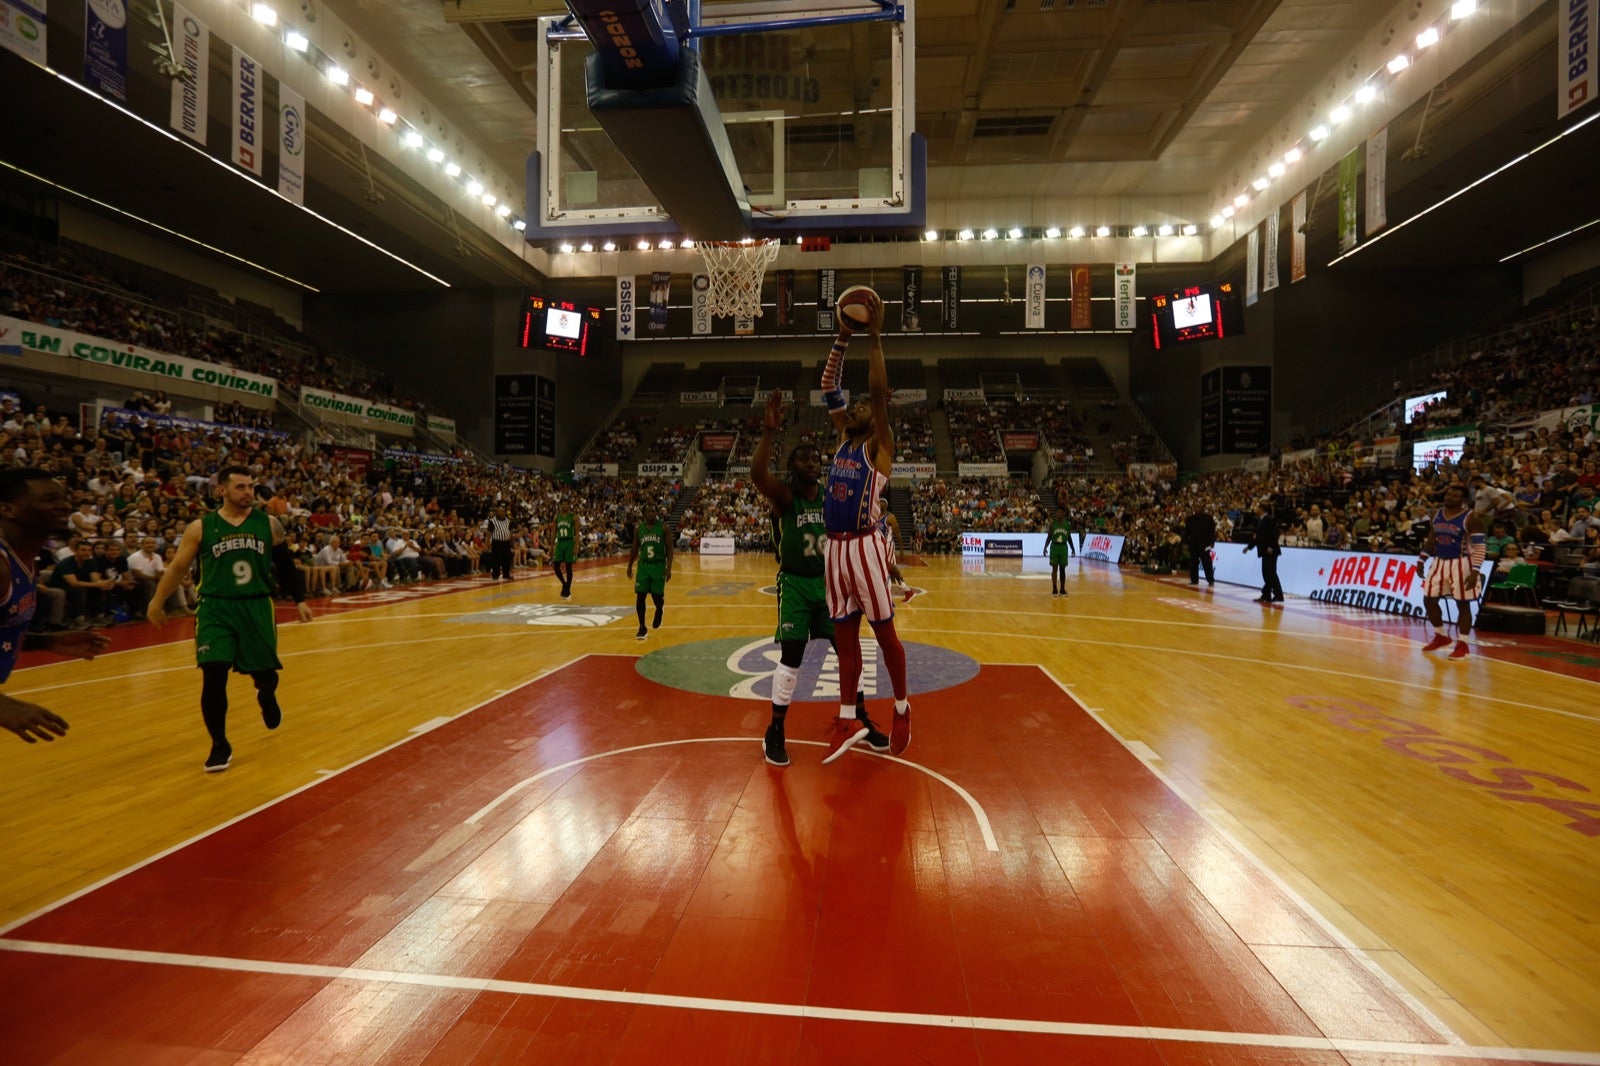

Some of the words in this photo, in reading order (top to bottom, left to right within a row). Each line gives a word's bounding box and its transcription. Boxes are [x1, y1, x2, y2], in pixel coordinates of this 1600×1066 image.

[599, 8, 645, 70] MONDO
[240, 58, 255, 146] BERNER
[620, 281, 631, 323] asisa
[697, 295, 707, 332] otero
[1033, 283, 1043, 316] Cuerva
[1120, 279, 1131, 327] fertisac
[74, 343, 183, 377] COVIRAN
[192, 368, 273, 396] COVIRAN
[304, 393, 362, 415] COVIRAN
[367, 407, 414, 425] COVIRAN
[642, 464, 667, 473] asisa
[212, 537, 265, 558] GENERALS
[559, 528, 568, 537] 11
[647, 546, 655, 558] 5
[232, 560, 253, 586] 9
[1327, 556, 1417, 598] HARLEM
